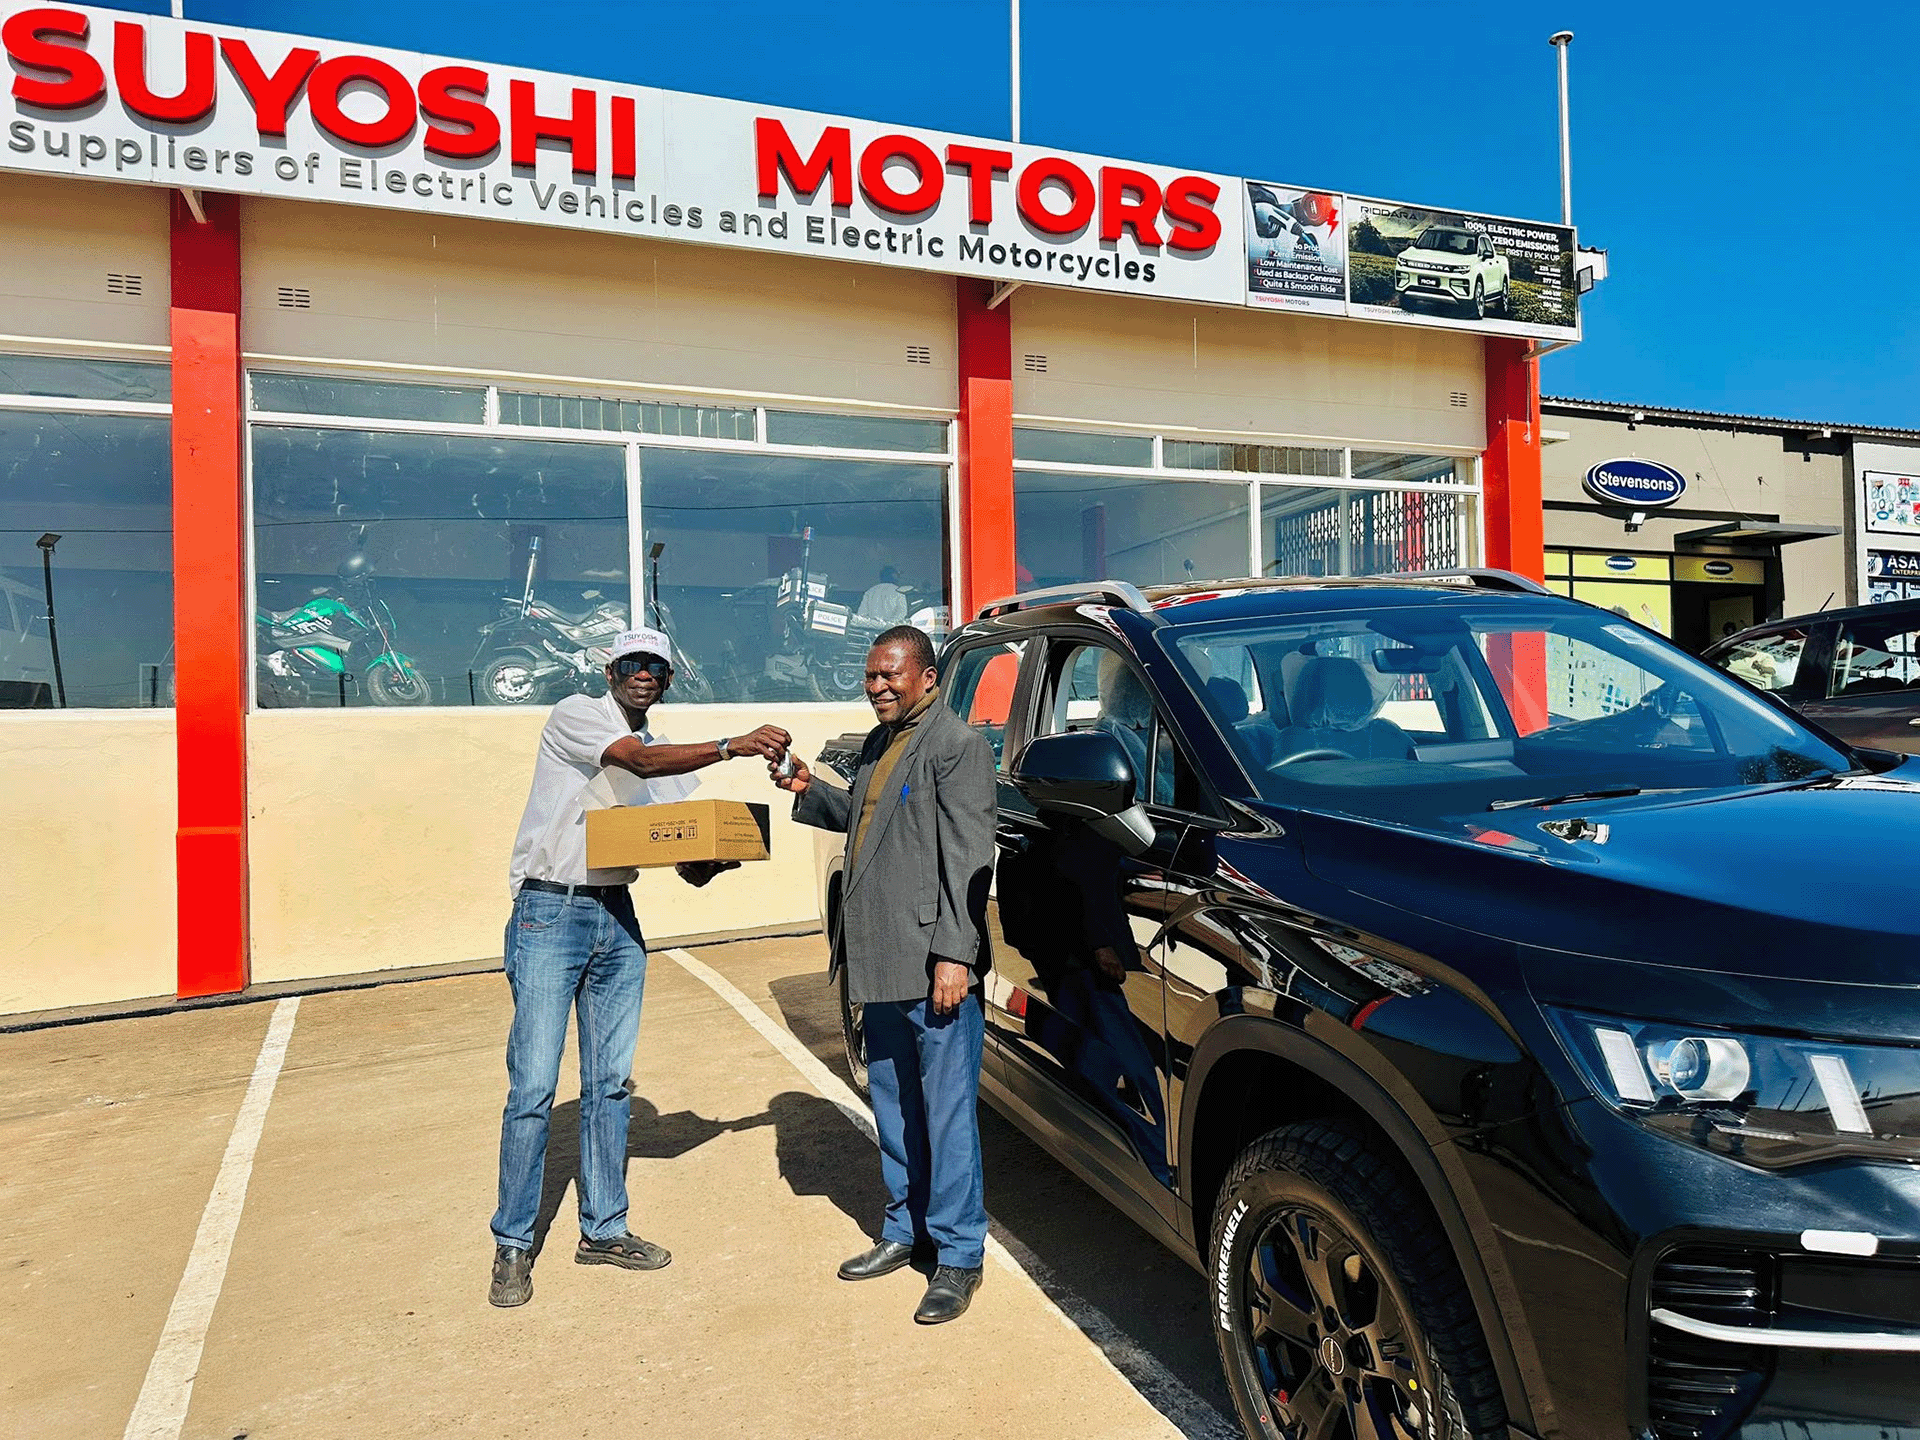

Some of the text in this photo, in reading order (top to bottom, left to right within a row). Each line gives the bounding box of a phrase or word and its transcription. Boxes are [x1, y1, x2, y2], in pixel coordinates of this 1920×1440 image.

[754, 117, 1222, 251] MOTORS
[8, 121, 1157, 283] Suppliers of Electric Vehicles and Electric Motorcycles
[1463, 221, 1486, 232] 100%
[1488, 224, 1525, 237] ELECTRIC
[1493, 236, 1559, 253] ZERO EMISSIONS
[1506, 248, 1523, 256] FIRST
[1524, 251, 1533, 259] EV
[1534, 252, 1549, 260] PICK
[1260, 259, 1275, 267] Low
[1276, 260, 1322, 272] Maintenance
[1256, 269, 1274, 277] Used
[1283, 271, 1309, 282] Backup
[1309, 274, 1342, 284] Generator
[1262, 279, 1283, 288] Quite
[1291, 281, 1319, 291] Smooth
[1320, 284, 1337, 293] Ride
[1285, 298, 1310, 306] MOTORS
[1598, 470, 1675, 491] Stevensons
[1218, 1199, 1250, 1332] PRIMEWELL
